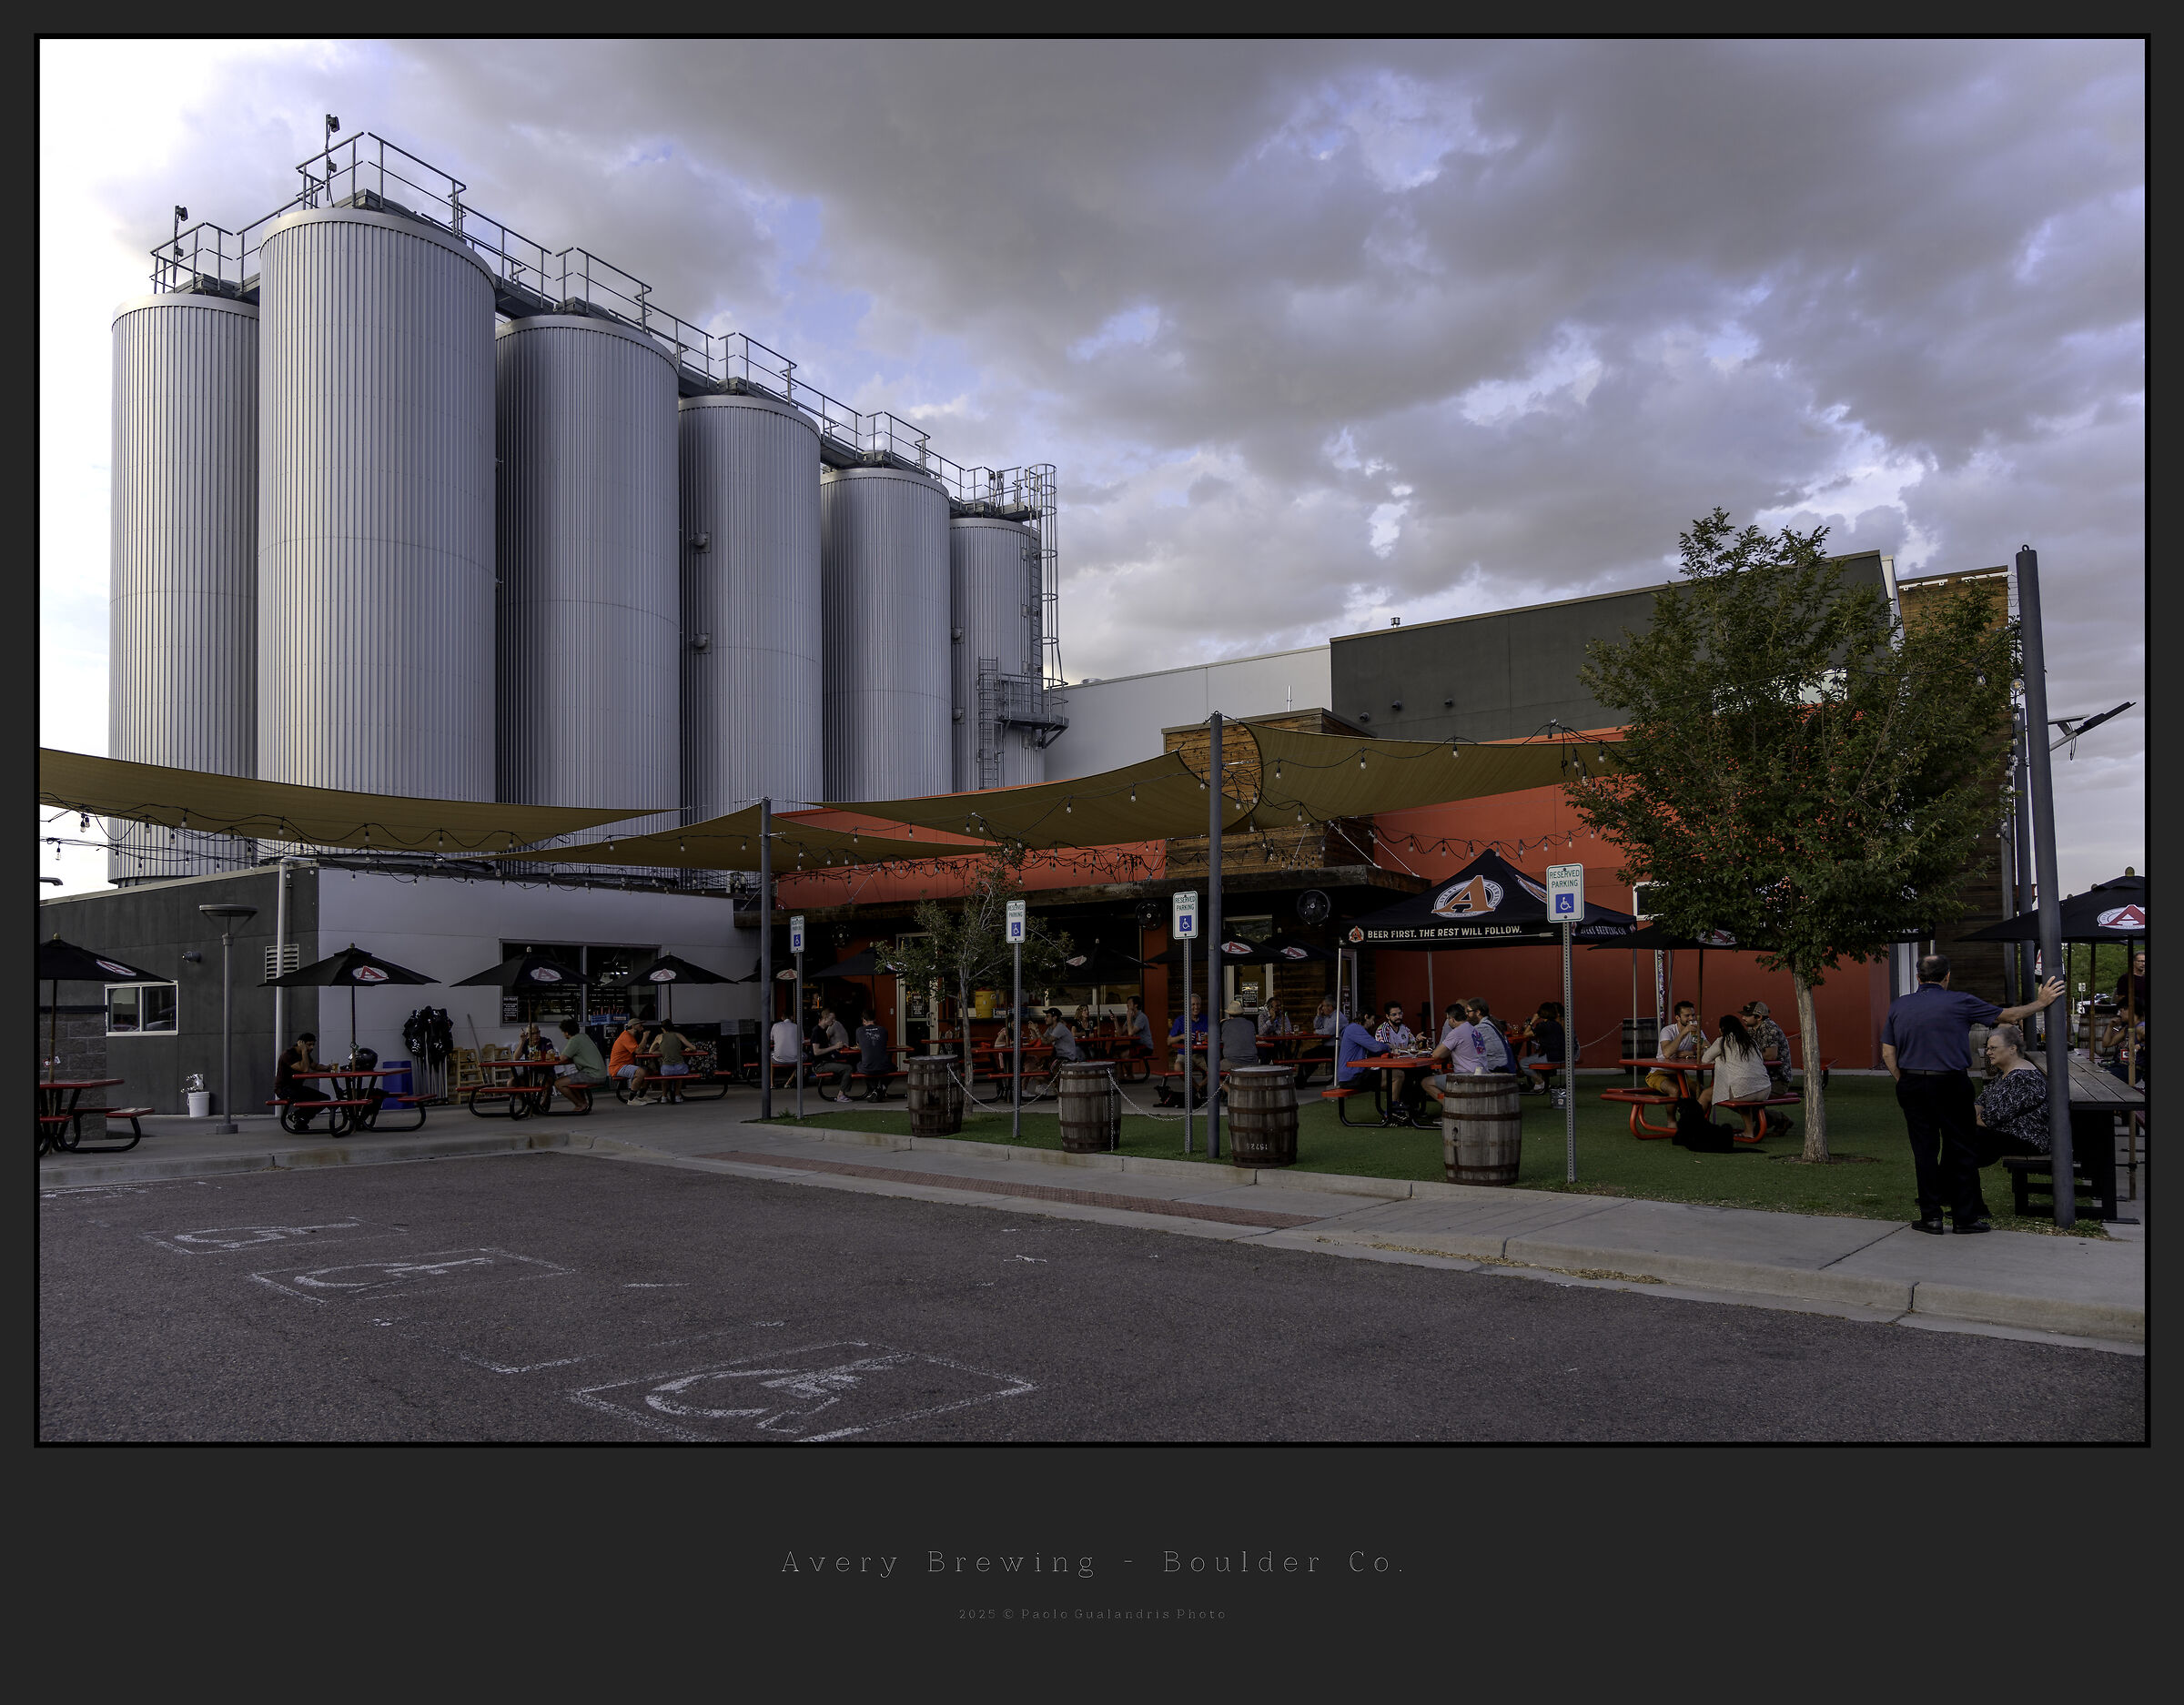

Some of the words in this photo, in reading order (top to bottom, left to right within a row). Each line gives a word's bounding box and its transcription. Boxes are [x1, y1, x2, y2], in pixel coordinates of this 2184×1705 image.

[1550, 869, 1581, 879] RESERVED
[1551, 879, 1579, 889] PARKING
[1431, 874, 1497, 913] A
[1368, 930, 1389, 939] BEER
[1390, 929, 1418, 939] FIRST.
[1419, 928, 1436, 938] THE
[1438, 927, 1460, 937] REST
[1461, 926, 1483, 936] WILL
[1484, 925, 1522, 935] FOLLOW.
